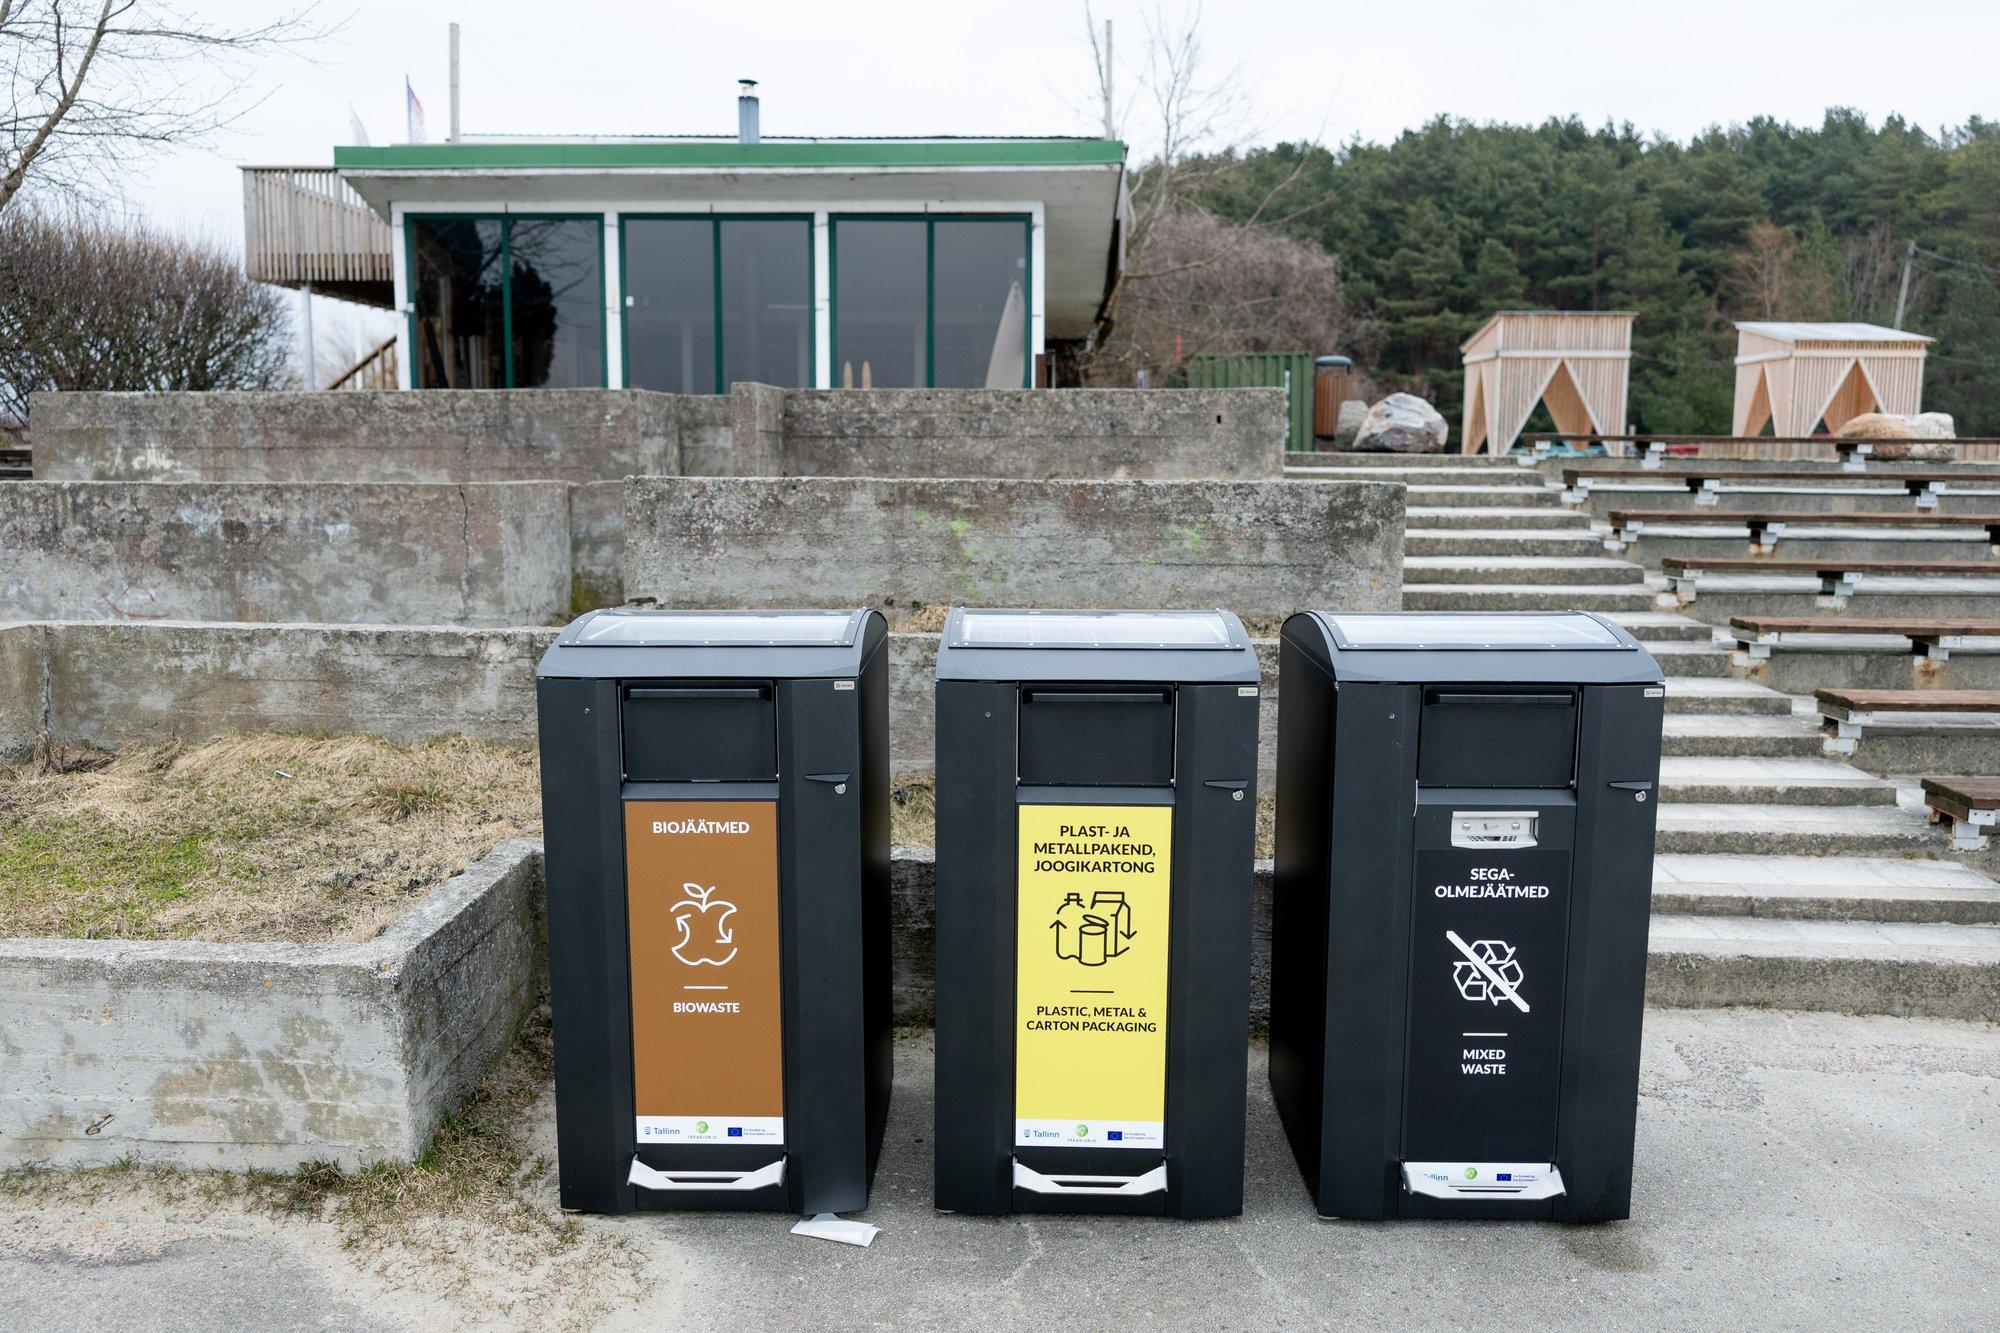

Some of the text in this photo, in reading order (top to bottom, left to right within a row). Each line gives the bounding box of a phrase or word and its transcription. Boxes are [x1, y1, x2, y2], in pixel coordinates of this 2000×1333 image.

[652, 818, 750, 834] BIOJÄÄTMED
[1060, 825, 1130, 838] PLAST- JA
[1033, 842, 1156, 857] METALLPAKEND,
[1033, 860, 1155, 873] JOOGIKARTONG
[1470, 867, 1515, 880] SEGA-
[1434, 883, 1549, 898] OLMEJÄÄTMED
[673, 1002, 740, 1013] BIOWASTE
[1036, 1006, 1147, 1018] PLASTIC, METAL &
[1026, 1020, 1157, 1033] CARTON PACKAGING
[1463, 1049, 1506, 1060] MIXED
[1461, 1064, 1506, 1075] WASTE
[653, 1127, 680, 1135] Tallinn
[1032, 1130, 1060, 1138] Tallinn
